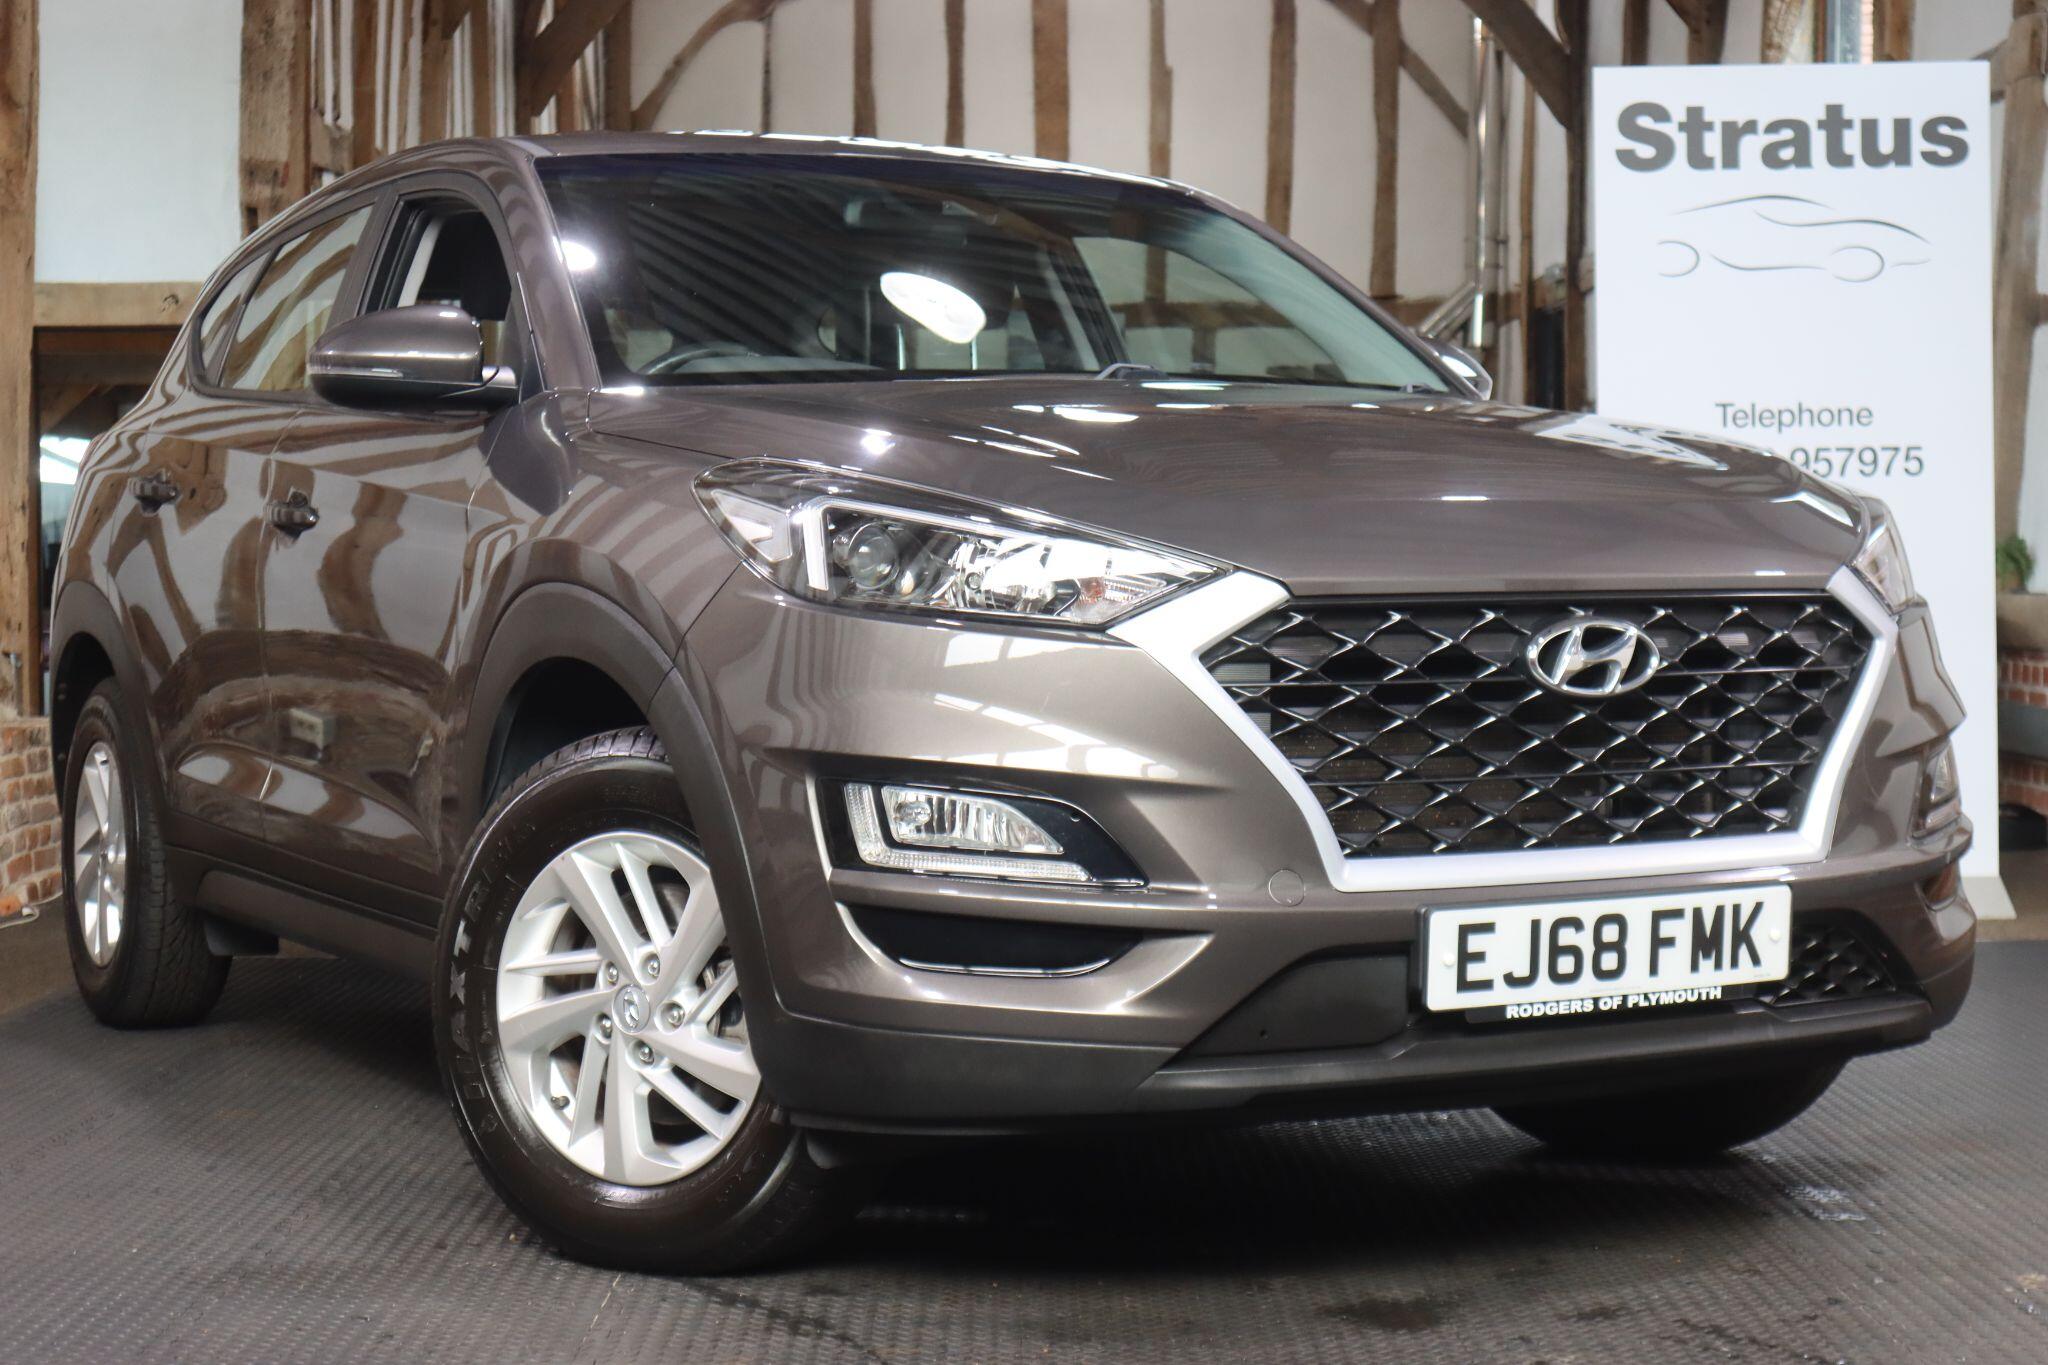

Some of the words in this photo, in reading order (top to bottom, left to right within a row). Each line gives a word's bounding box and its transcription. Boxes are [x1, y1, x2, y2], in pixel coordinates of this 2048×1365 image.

[1615, 101, 1970, 173] Stratus
[1715, 400, 1875, 434] Telephone
[1790, 446, 1925, 478] 957975
[1456, 912, 1629, 994] EJ68
[1648, 901, 1765, 978] FMK
[1505, 998, 1594, 1019] RODGERS
[1599, 995, 1624, 1012] OF
[1627, 986, 1722, 1009] PLYMOUTH
